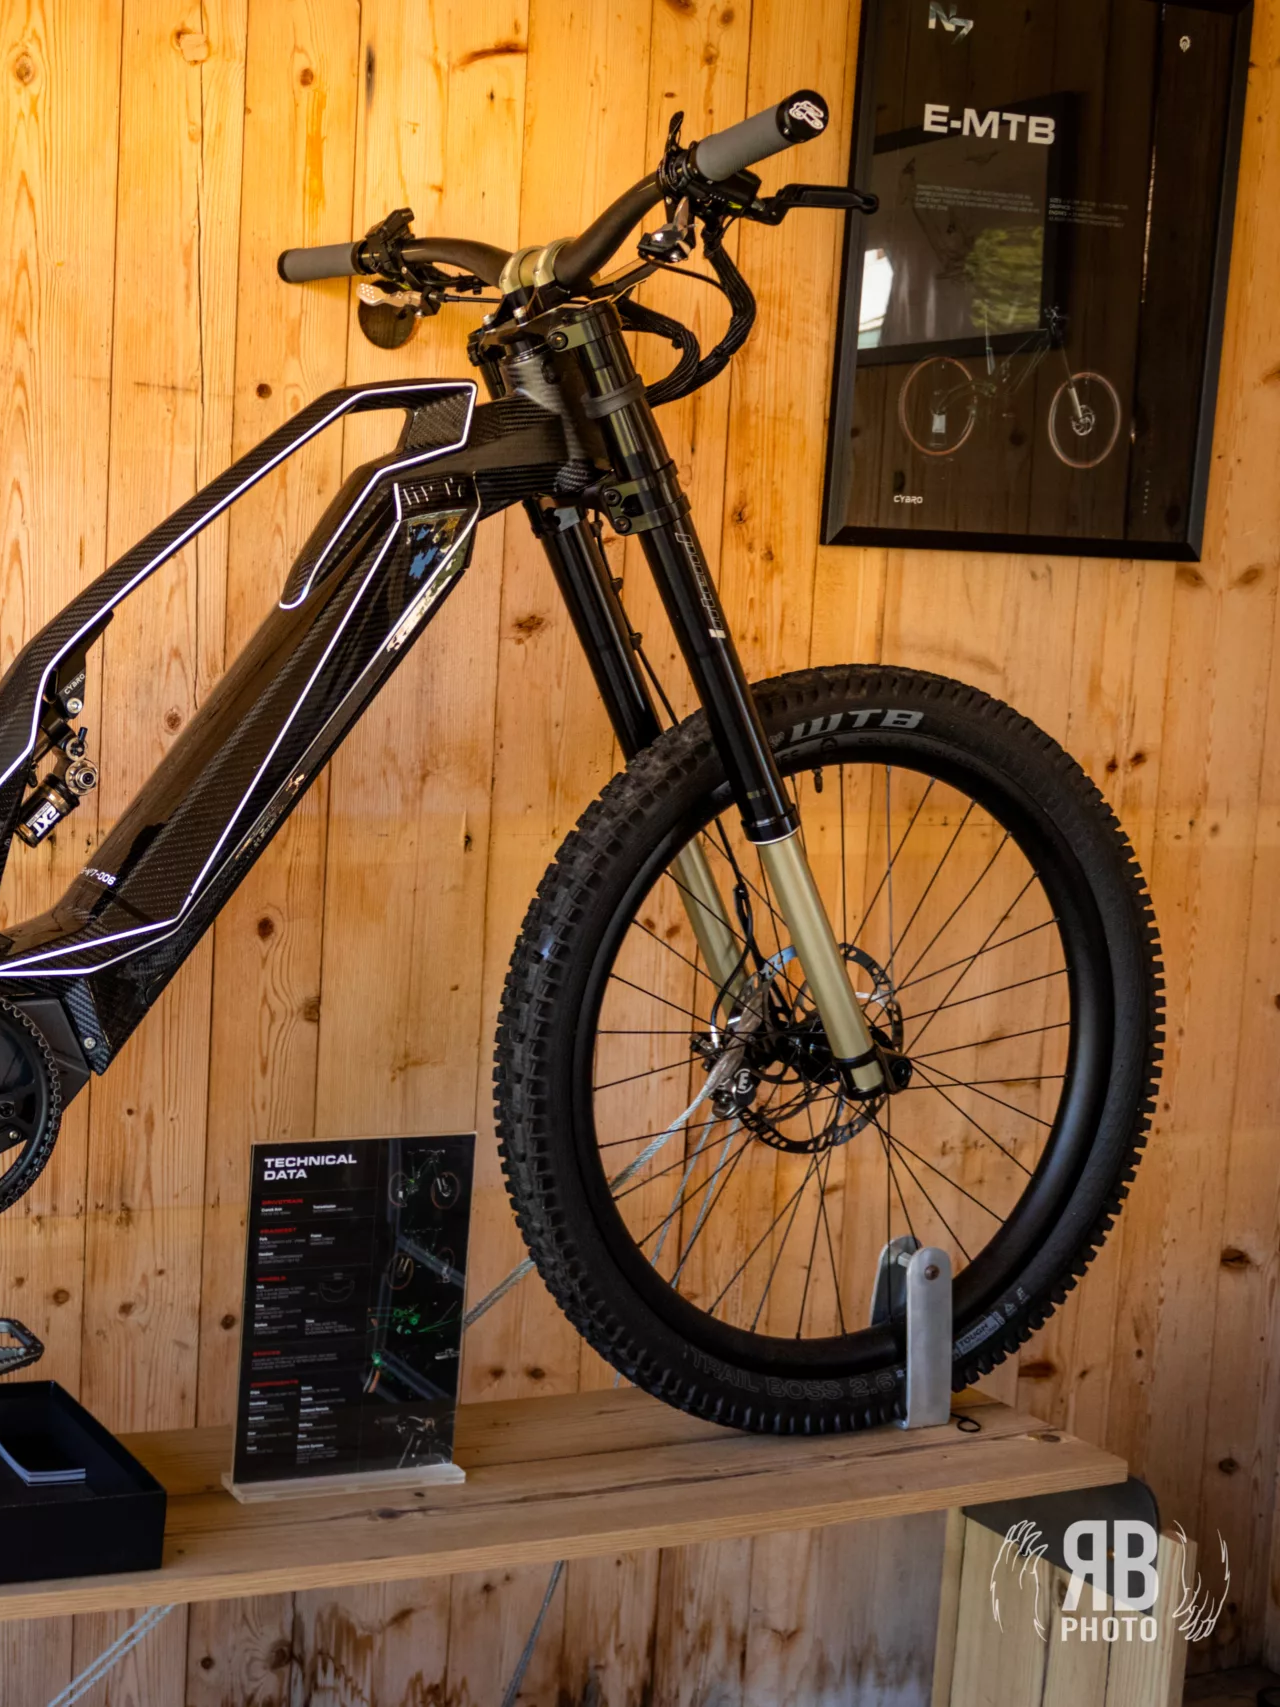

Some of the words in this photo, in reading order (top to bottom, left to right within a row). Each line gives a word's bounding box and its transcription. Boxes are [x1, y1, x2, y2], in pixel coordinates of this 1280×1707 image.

[923, 103, 1056, 145] E-MTB
[893, 494, 923, 504] CYBRO
[64, 673, 85, 696] CYBRO
[789, 708, 925, 743] WTB
[32, 804, 60, 838] EXT
[263, 1153, 358, 1168] TECHNICAL
[263, 1168, 308, 1181] DATA
[958, 1323, 989, 1347] TOUGH
[690, 1345, 760, 1393] TRAIL
[764, 1376, 844, 1400] BOSS
